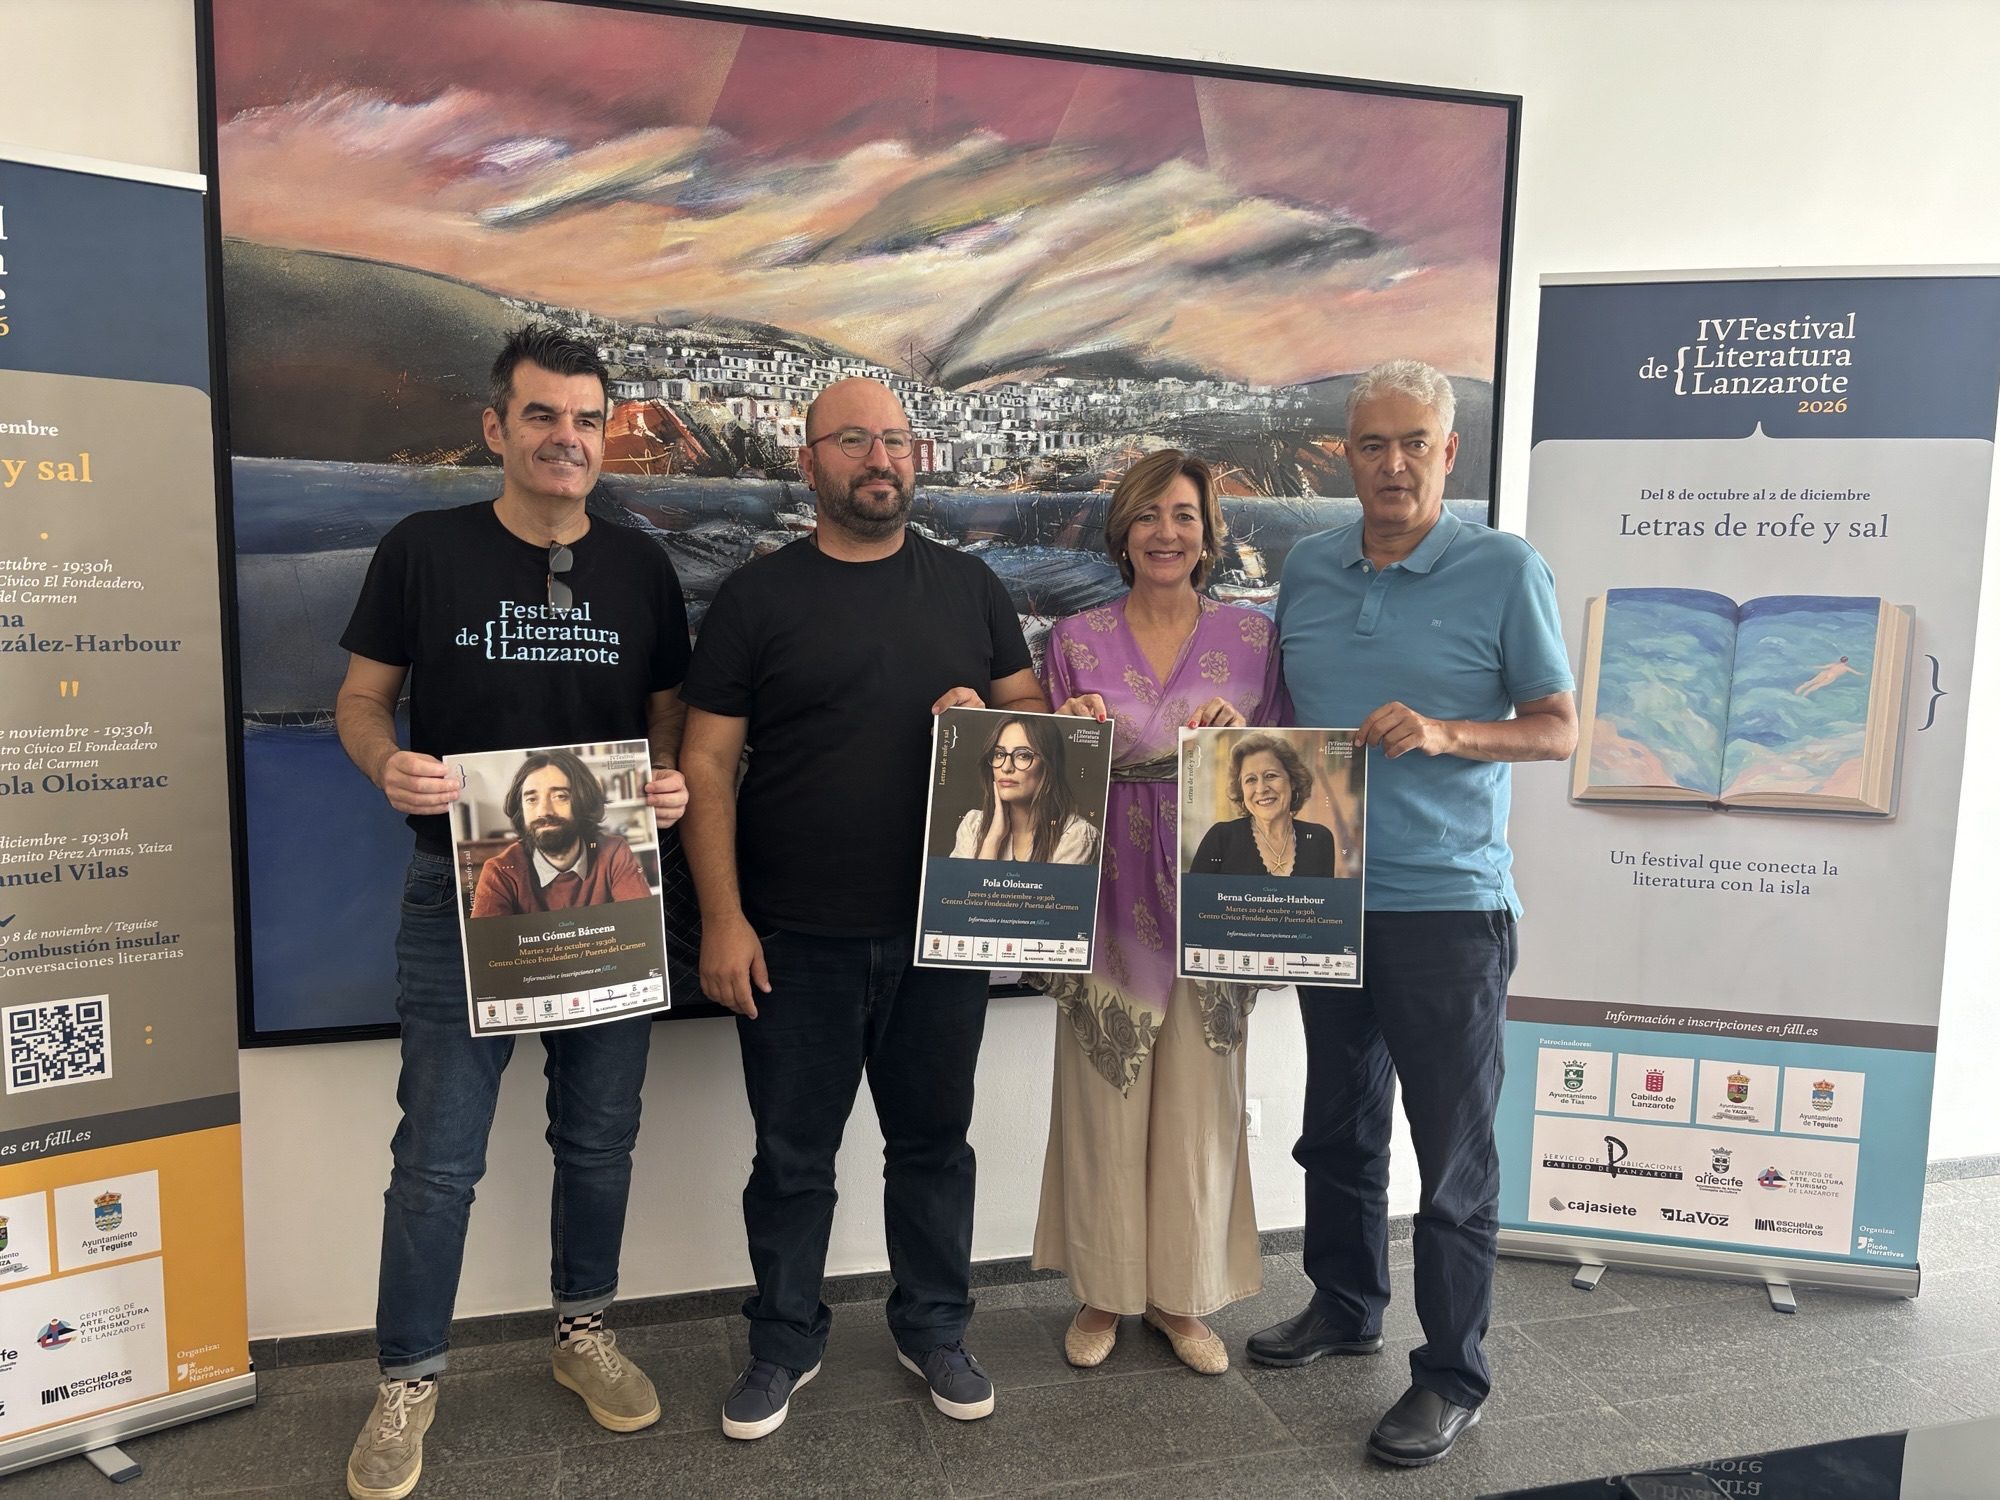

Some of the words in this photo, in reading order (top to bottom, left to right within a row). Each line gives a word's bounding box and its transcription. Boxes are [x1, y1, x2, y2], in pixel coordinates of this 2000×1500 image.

[1694, 344, 1852, 368] Literatura
[1639, 357, 1668, 379] de
[1692, 372, 1849, 395] Lanzarote
[1798, 398, 1848, 413] 2026
[1, 459, 27, 488] y
[38, 453, 95, 483] sal
[1641, 490, 1664, 500] Del
[1668, 490, 1674, 500] 8
[1678, 490, 1694, 500] de
[1698, 490, 1749, 500] octubre
[1753, 490, 1765, 500] al
[1769, 492, 1776, 500] 2
[1780, 490, 1797, 500] de
[1800, 490, 1870, 501] diciembre
[1620, 513, 1704, 537] Letras
[1714, 513, 1747, 537] de
[1756, 513, 1815, 538] rofe
[1822, 521, 1840, 544] y
[1849, 514, 1889, 538] sal
[63, 560, 113, 574] 19:30h
[44, 575, 58, 588] El
[62, 577, 145, 590] Fondeadero,
[21, 592, 77, 604] Carmen
[500, 601, 591, 621] Festival
[456, 628, 479, 645] de
[500, 621, 620, 645] Literatura
[1, 633, 181, 652] zález-Harbour
[500, 641, 619, 664] Lanzarote
[9, 724, 89, 739] noviembre
[104, 722, 153, 738] 19:30h
[24, 744, 64, 755] Cívico
[68, 743, 81, 753] El
[85, 740, 158, 753] Fondeadero
[24, 758, 42, 769] del
[47, 758, 99, 768] Carmen
[42, 773, 168, 793] Oloixarac
[82, 828, 129, 845] 19:30h
[1, 852, 43, 864] Benito
[48, 849, 83, 860] Pérez
[86, 846, 134, 858] Armas,
[138, 844, 172, 853] Yaiza
[68, 862, 129, 880] Vilas
[1610, 851, 1636, 865] Un
[1641, 851, 1704, 869] festival
[1709, 860, 1741, 873] que
[1747, 862, 1816, 875] conecta
[1822, 861, 1838, 876] la
[983, 879, 1000, 887] Pola
[1003, 880, 1043, 889] Oloixarac
[1633, 872, 1715, 890] literatura
[1721, 881, 1753, 892] con
[1760, 879, 1774, 893] la
[1780, 880, 1810, 895] isla
[1218, 893, 1242, 901] Berna
[1245, 894, 1324, 904] González-Harbour
[1, 935, 9, 946] y
[13, 933, 20, 941] 8
[24, 930, 37, 941] de
[41, 925, 103, 939] noviembre
[115, 919, 158, 932] Teguise
[116, 932, 180, 949] insular
[518, 935, 540, 946] Juan
[543, 930, 576, 941] Gómez
[578, 924, 615, 936] Bárcena
[119, 948, 184, 964] literarias
[489, 959, 513, 968] Centro
[514, 956, 537, 966] Cívico
[538, 952, 579, 963] Fondeadero
[585, 948, 607, 957] Puerto
[609, 945, 619, 954] del
[620, 941, 645, 951] Carmen
[520, 947, 544, 956] Martes
[565, 941, 590, 950] octubre
[1605, 1011, 1675, 1025] Información
[1688, 1016, 1763, 1032] inscripciones
[1766, 1025, 1779, 1033] en
[1779, 1024, 1818, 1036] fdll.es
[1540, 1038, 1591, 1047] Patrocinadores:
[1549, 1091, 1597, 1100] Ayuntamiento
[1631, 1093, 1663, 1102] Cabildo
[1632, 1100, 1674, 1110] Lanzarote
[1800, 1113, 1842, 1122] Ayuntamiento
[1813, 1121, 1838, 1129] Teguise
[22, 1140, 40, 1151] en
[41, 1130, 91, 1152] fdll.es
[1544, 1154, 1584, 1162] SERVICIO
[1547, 1161, 1591, 1170] CABILDO
[1617, 1168, 1679, 1179] LANZAROTE
[1568, 1200, 1637, 1216] cajasiete
[1776, 1226, 1823, 1236] escritores
[1777, 1220, 1813, 1229] escuela
[1859, 1225, 1894, 1234] Organiza:
[82, 1230, 138, 1248] Ayuntamiento
[1868, 1242, 1887, 1251] Picón
[88, 1247, 98, 1255] de
[100, 1240, 132, 1252] Teguise
[1867, 1249, 1904, 1257] Narrativas
[80, 1306, 121, 1320] CENTROS
[109, 1307, 149, 1321] CULTURA
[81, 1335, 92, 1344] DE
[95, 1323, 146, 1340] LANZAROTE
[89, 1319, 129, 1333] TURISMO
[177, 1343, 220, 1359] Organiza:
[189, 1364, 214, 1375] Picón
[189, 1366, 235, 1383] Narrativas
[71, 1371, 118, 1389] escuela
[71, 1375, 132, 1397] escritores
